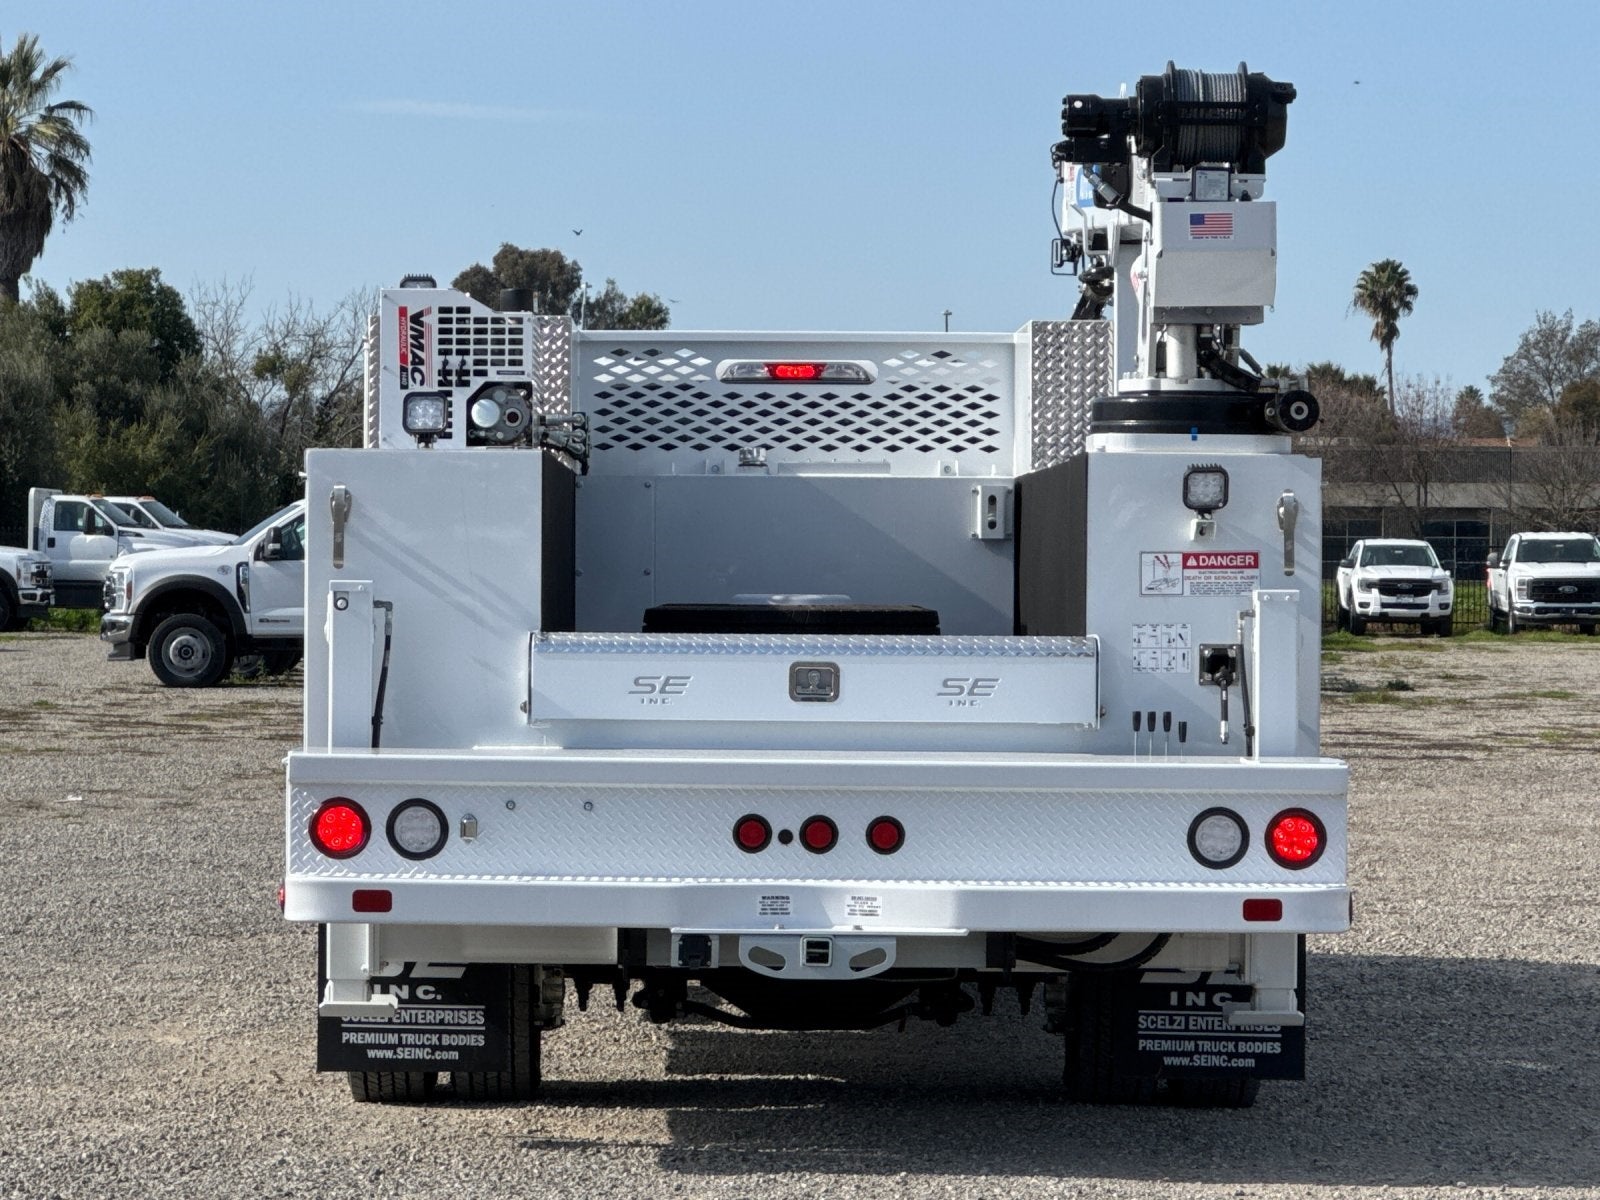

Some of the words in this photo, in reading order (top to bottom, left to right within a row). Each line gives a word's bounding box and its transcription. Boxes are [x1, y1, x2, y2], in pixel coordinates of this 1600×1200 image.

[400, 316, 408, 355] HYDRAULIC
[409, 308, 426, 387] VMAC
[1199, 555, 1255, 566] DANGER
[627, 675, 693, 695] SE
[936, 677, 1002, 697] SE
[373, 984, 443, 1001] INC.
[393, 1009, 485, 1025] ENTERPRISES
[1138, 1015, 1185, 1030] SCELZI
[341, 1031, 399, 1045] PREMIUM
[400, 1033, 440, 1046] TRUCK
[441, 1034, 485, 1047] BODIES
[1138, 1040, 1195, 1052] PREMIUM
[1197, 1041, 1236, 1053] TRUCK
[1237, 1042, 1282, 1054] BODIES
[366, 1047, 459, 1060] www.SEINC.com
[1163, 1055, 1256, 1068] www.SEINC.com
